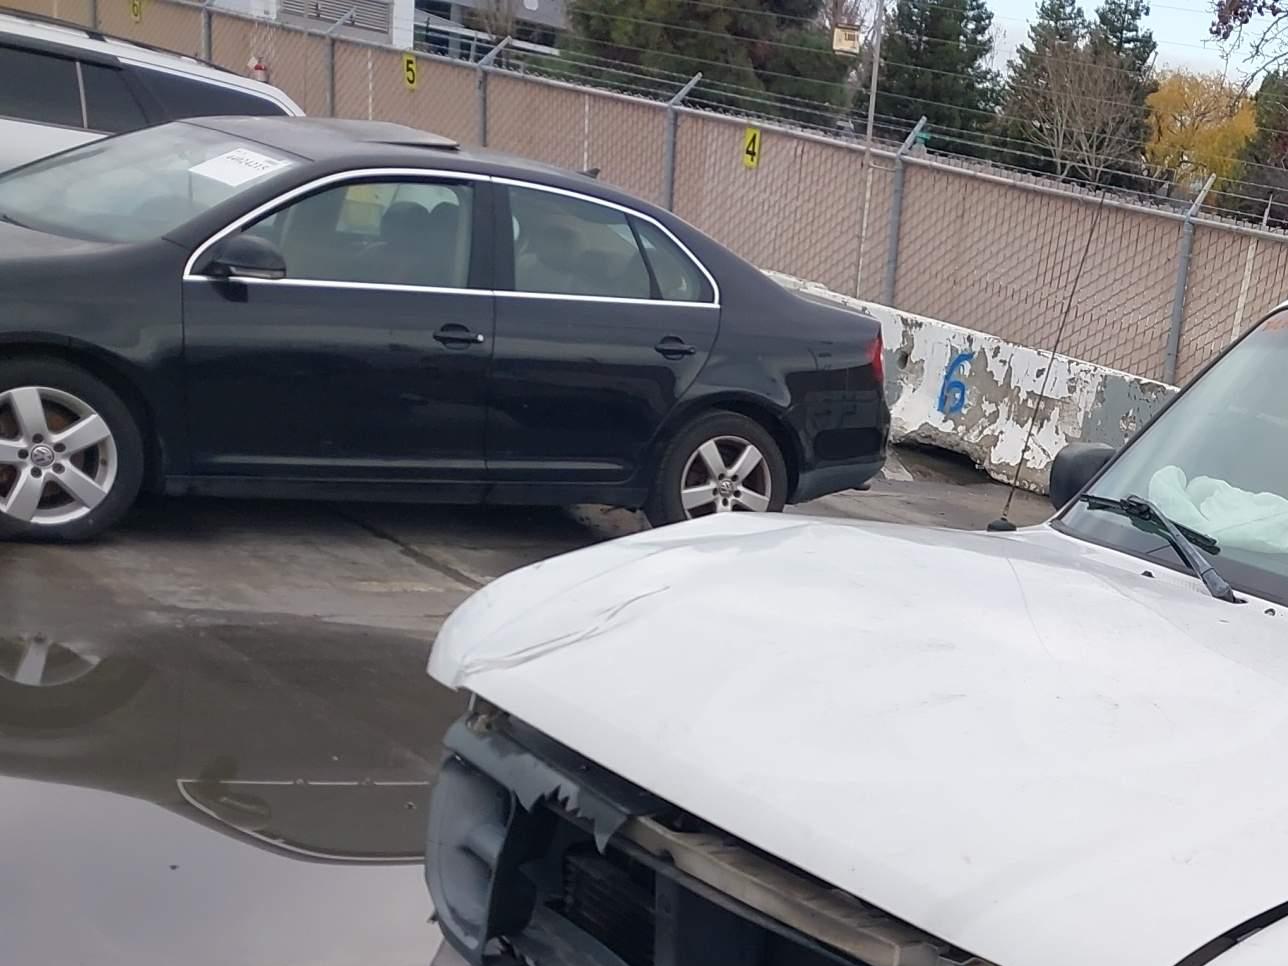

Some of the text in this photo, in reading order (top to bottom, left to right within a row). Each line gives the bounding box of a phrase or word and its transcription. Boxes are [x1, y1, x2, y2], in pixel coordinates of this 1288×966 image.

[406, 59, 416, 84] 5
[745, 132, 757, 162] 4
[937, 352, 974, 414] 6
